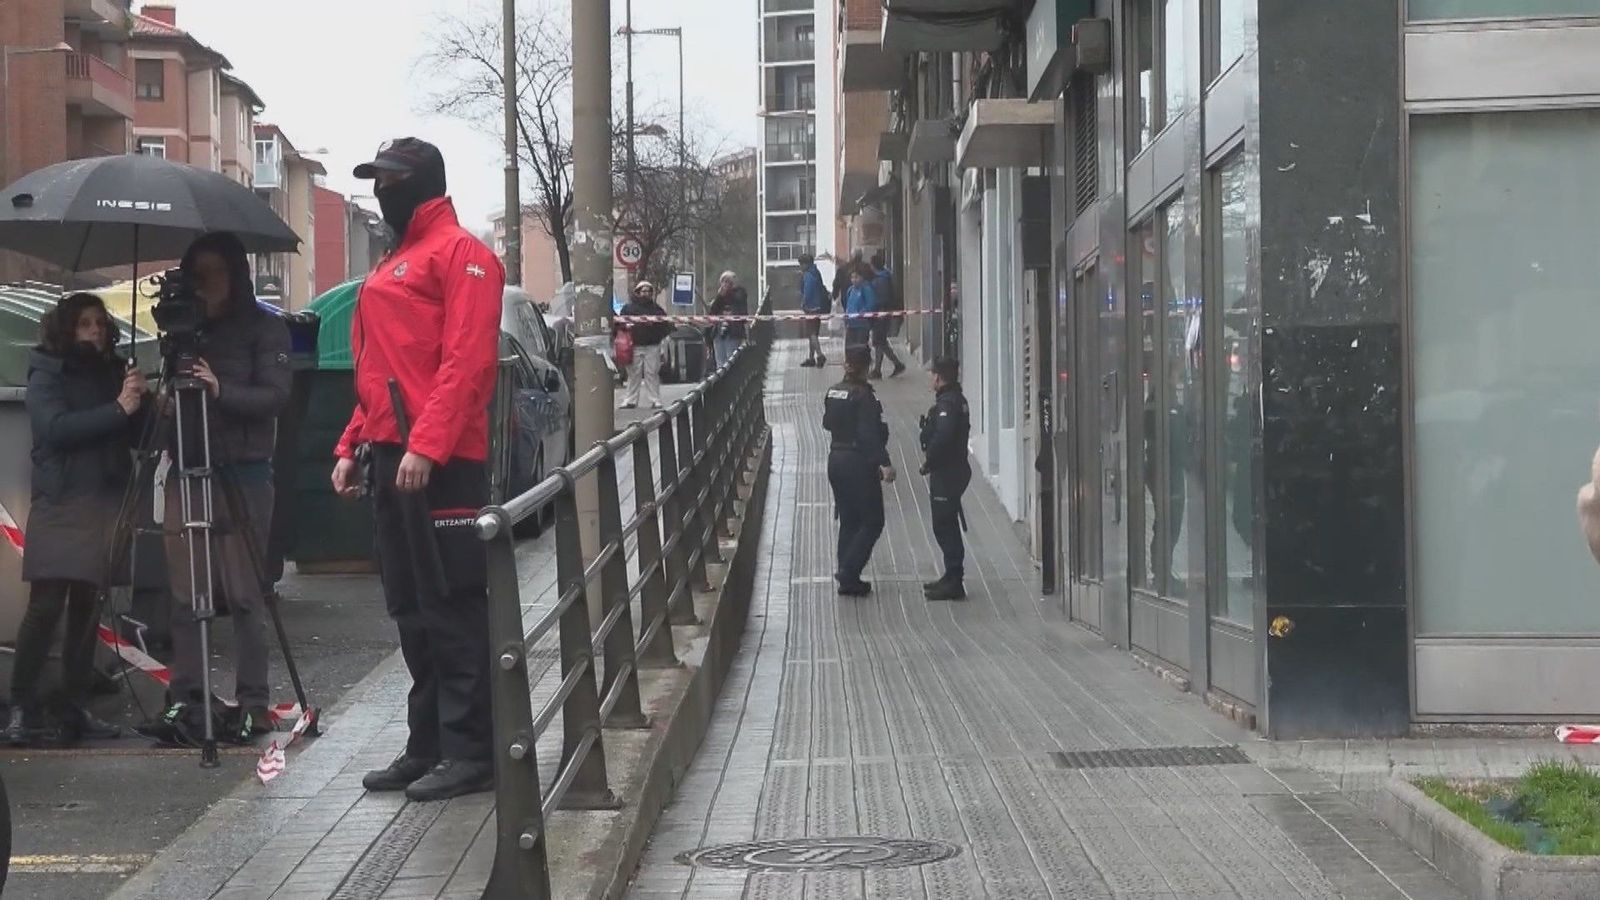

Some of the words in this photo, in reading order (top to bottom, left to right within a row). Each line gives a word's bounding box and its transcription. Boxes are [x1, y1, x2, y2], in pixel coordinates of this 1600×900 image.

[96, 199, 172, 212] INESIS
[623, 246, 640, 258] 30
[434, 517, 477, 528] ERTZAINTZ
